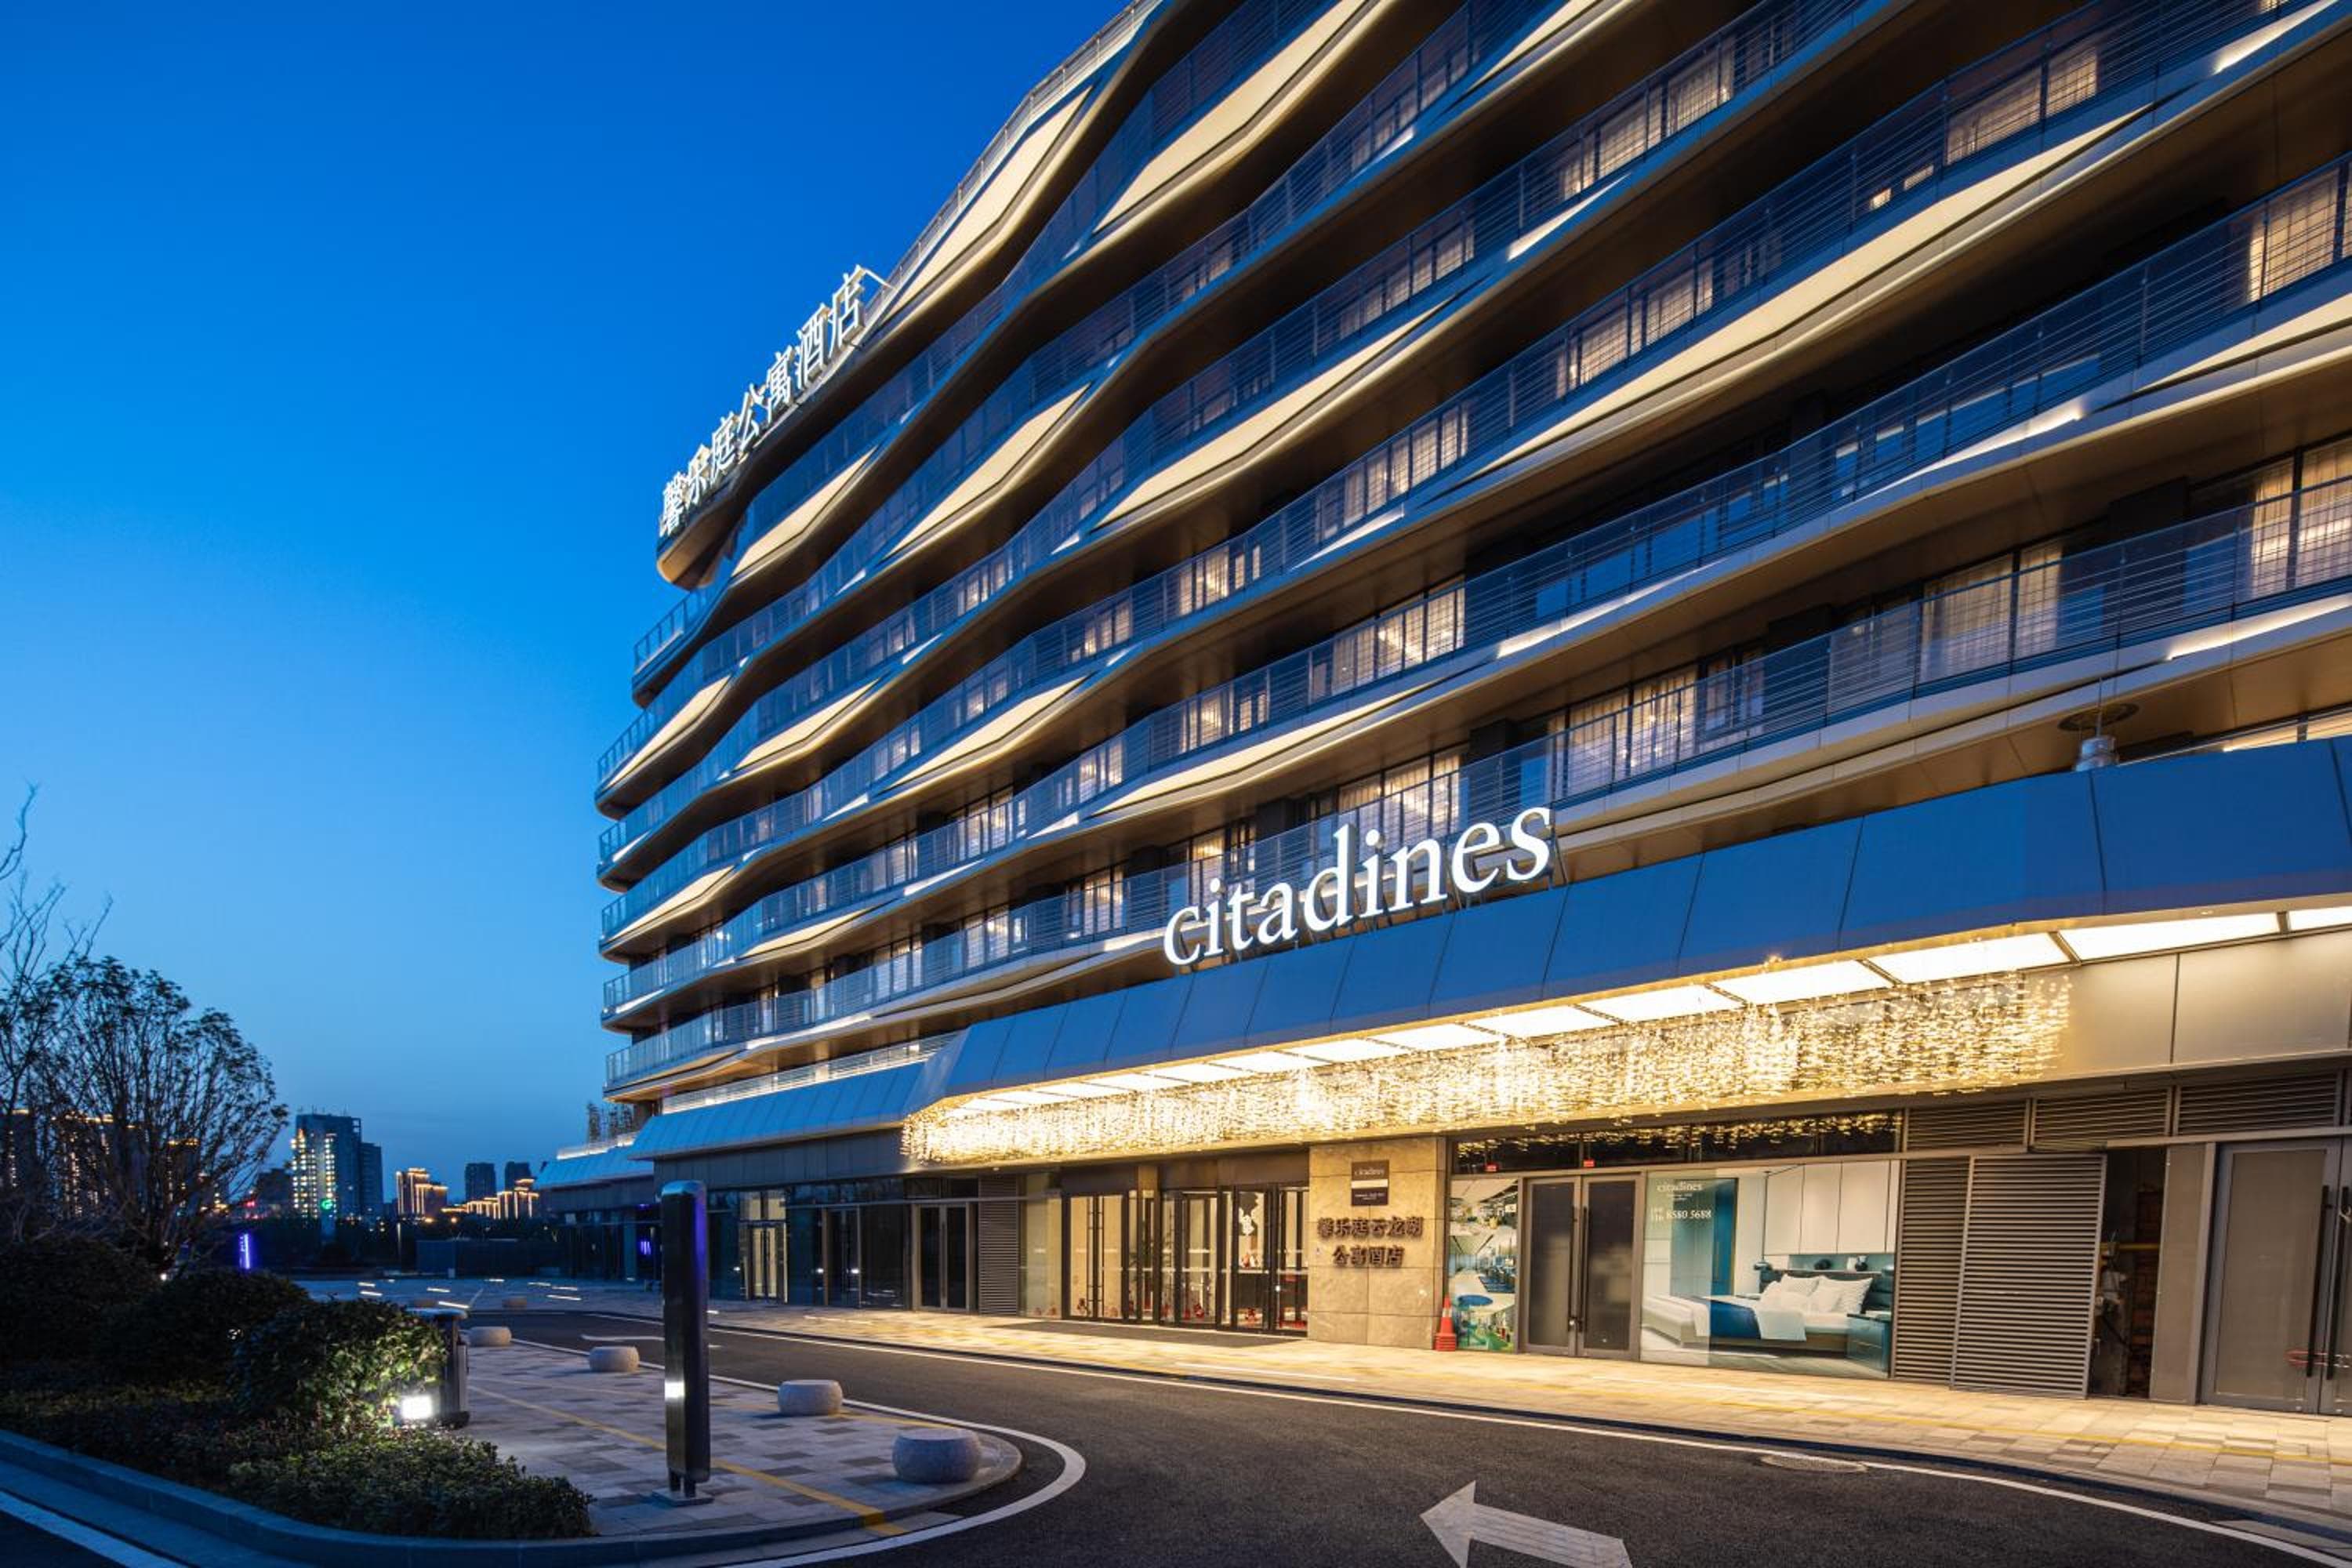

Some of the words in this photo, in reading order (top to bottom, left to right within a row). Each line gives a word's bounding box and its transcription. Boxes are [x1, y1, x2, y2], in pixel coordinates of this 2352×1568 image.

[659, 264, 863, 537] 馨乐庭公寓酒店
[1163, 807, 1552, 966] citadines
